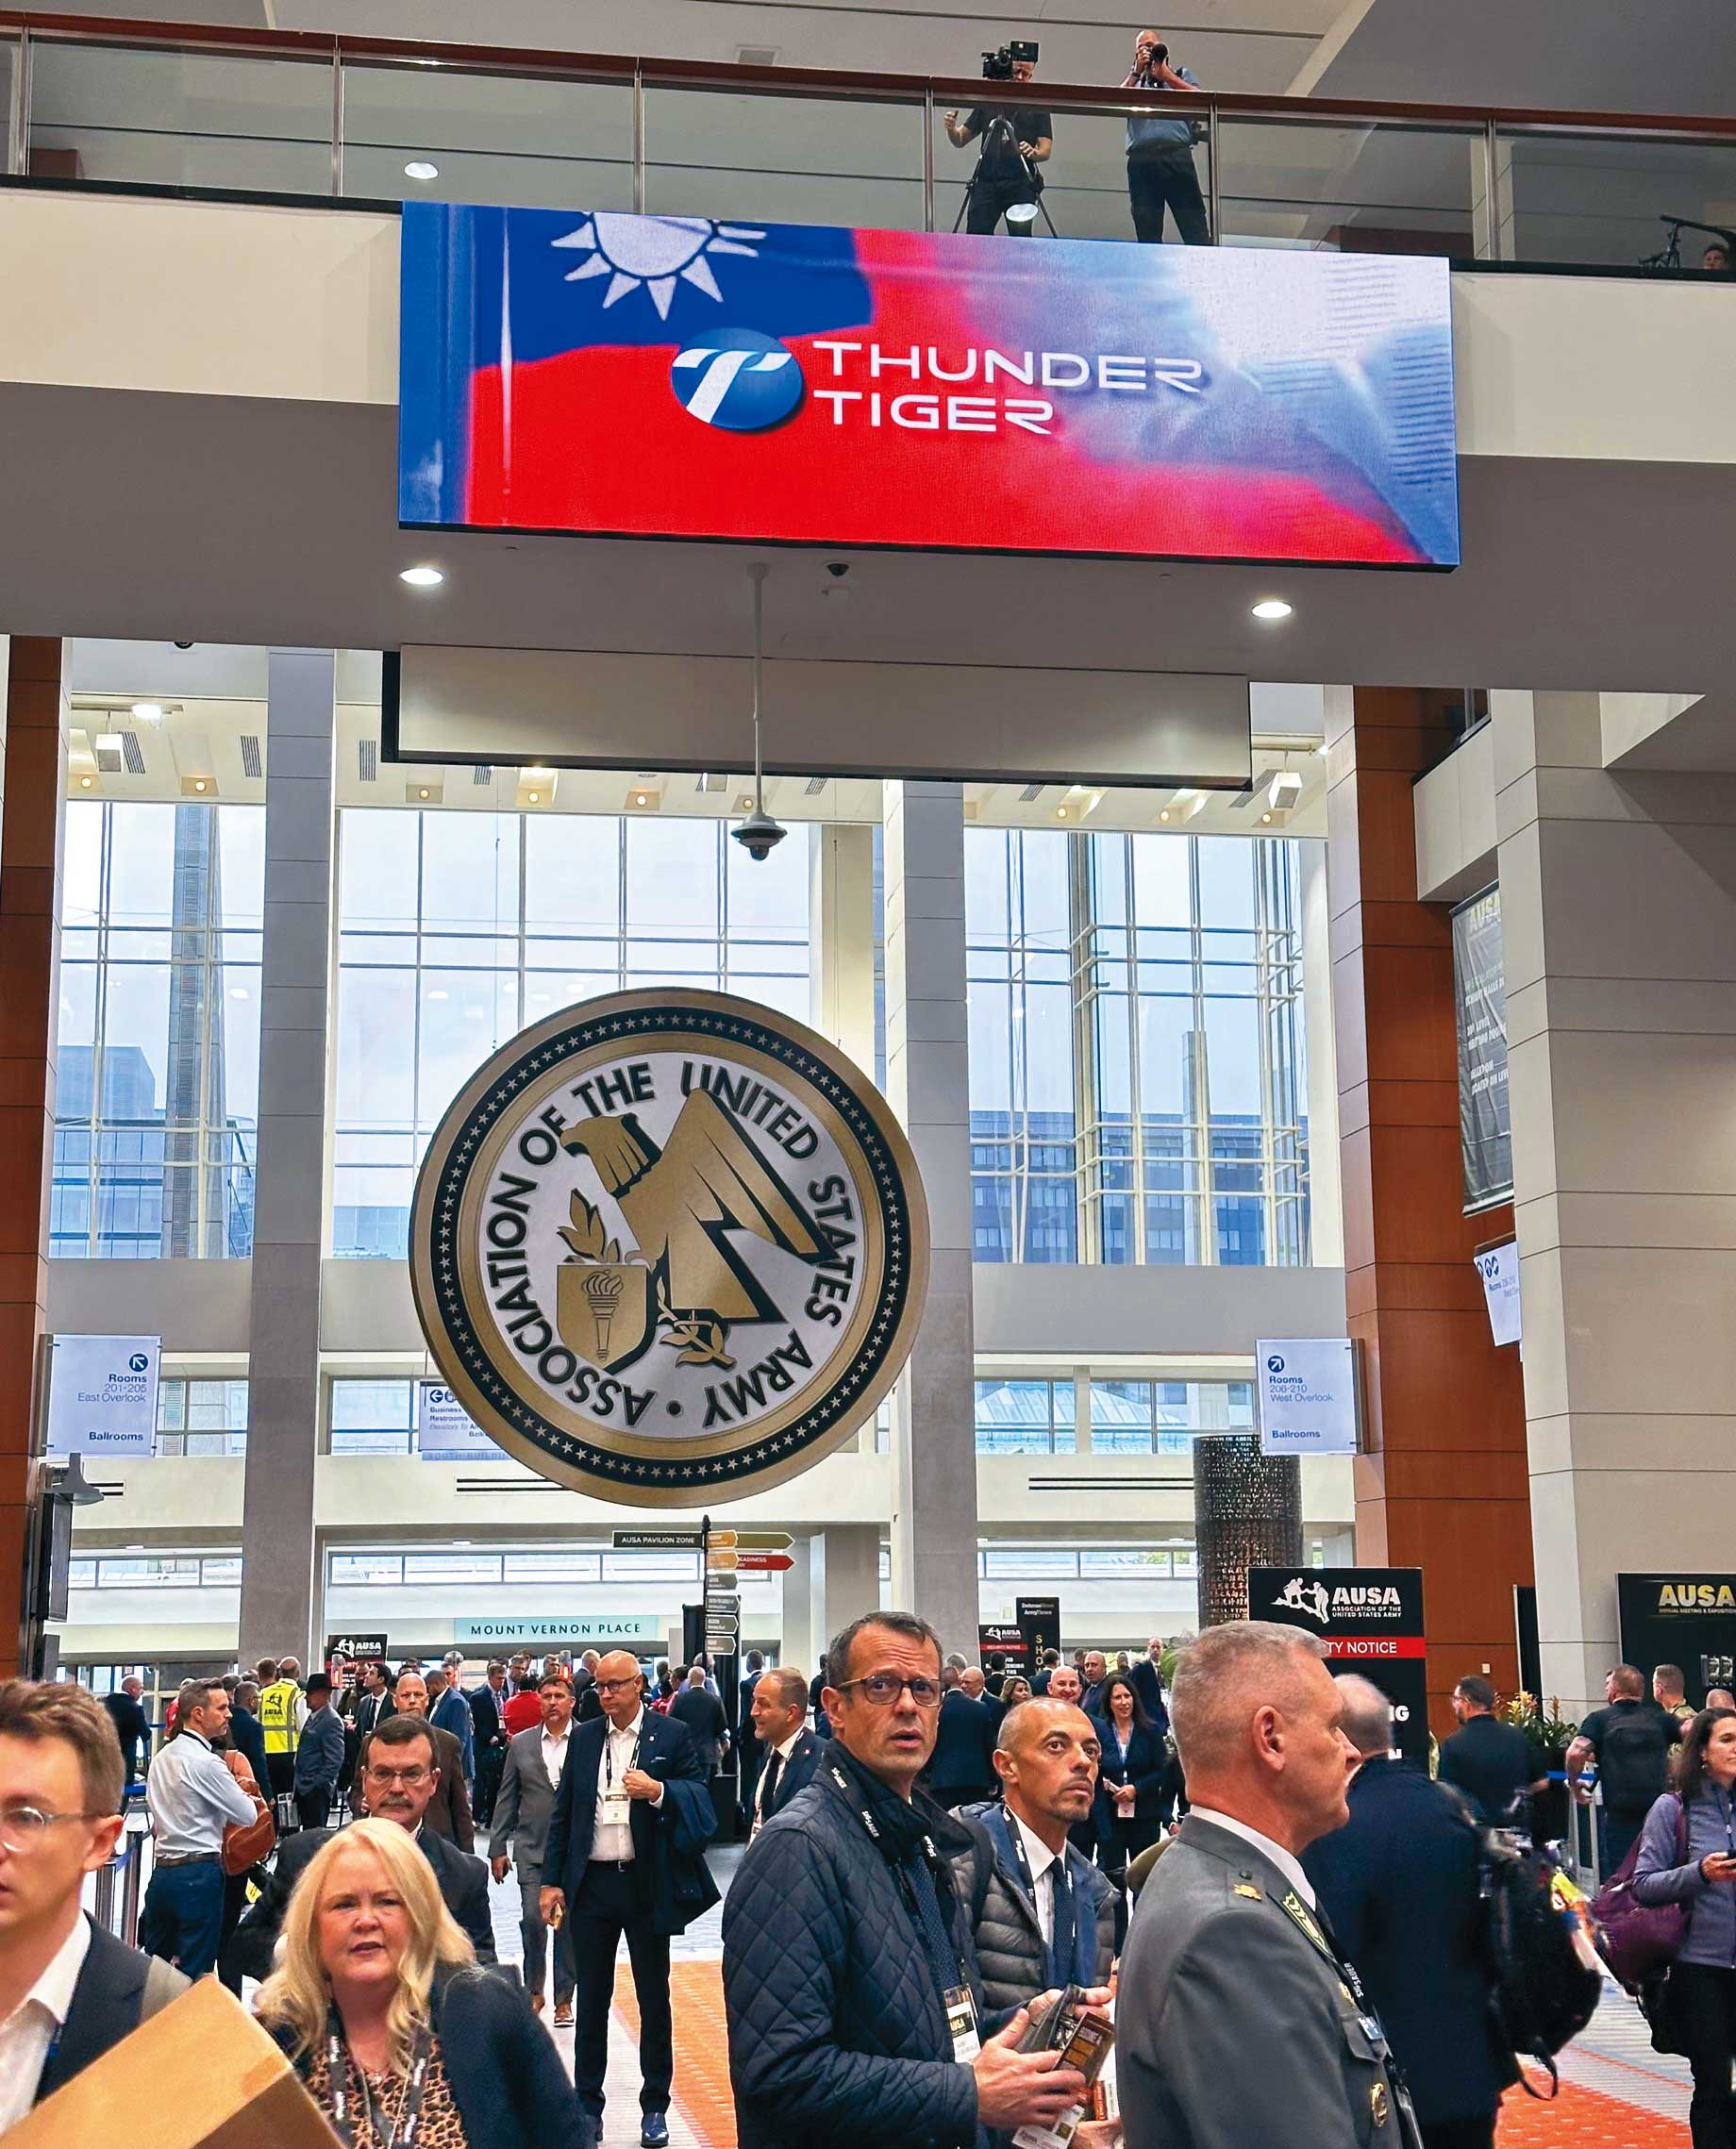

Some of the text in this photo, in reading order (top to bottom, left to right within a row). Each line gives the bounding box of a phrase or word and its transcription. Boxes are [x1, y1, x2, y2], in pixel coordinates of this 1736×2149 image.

[813, 341, 1203, 393] THUNDER
[813, 391, 1054, 435] TIGER
[488, 1060, 857, 1428] ASSOCIATION OF THE UNITED STATES ARMY
[108, 1374, 147, 1383] Rooms
[1269, 1375, 1303, 1384] Rooms
[105, 1384, 147, 1393] 201-205
[1270, 1385, 1308, 1393] 206-210
[77, 1392, 146, 1403] East Overlook
[1270, 1393, 1334, 1402] West Overlook
[89, 1431, 143, 1441] Ballrooms
[1272, 1430, 1321, 1439] Ballrooms
[1332, 1587, 1401, 1605] AUSA
[1659, 1585, 1736, 1607] AUSA
[471, 1623, 642, 1635] MOUNT VERNON PLACE
[1347, 1641, 1397, 1654] NOTICE
[1344, 1962, 1364, 1998] SIG SAUER
